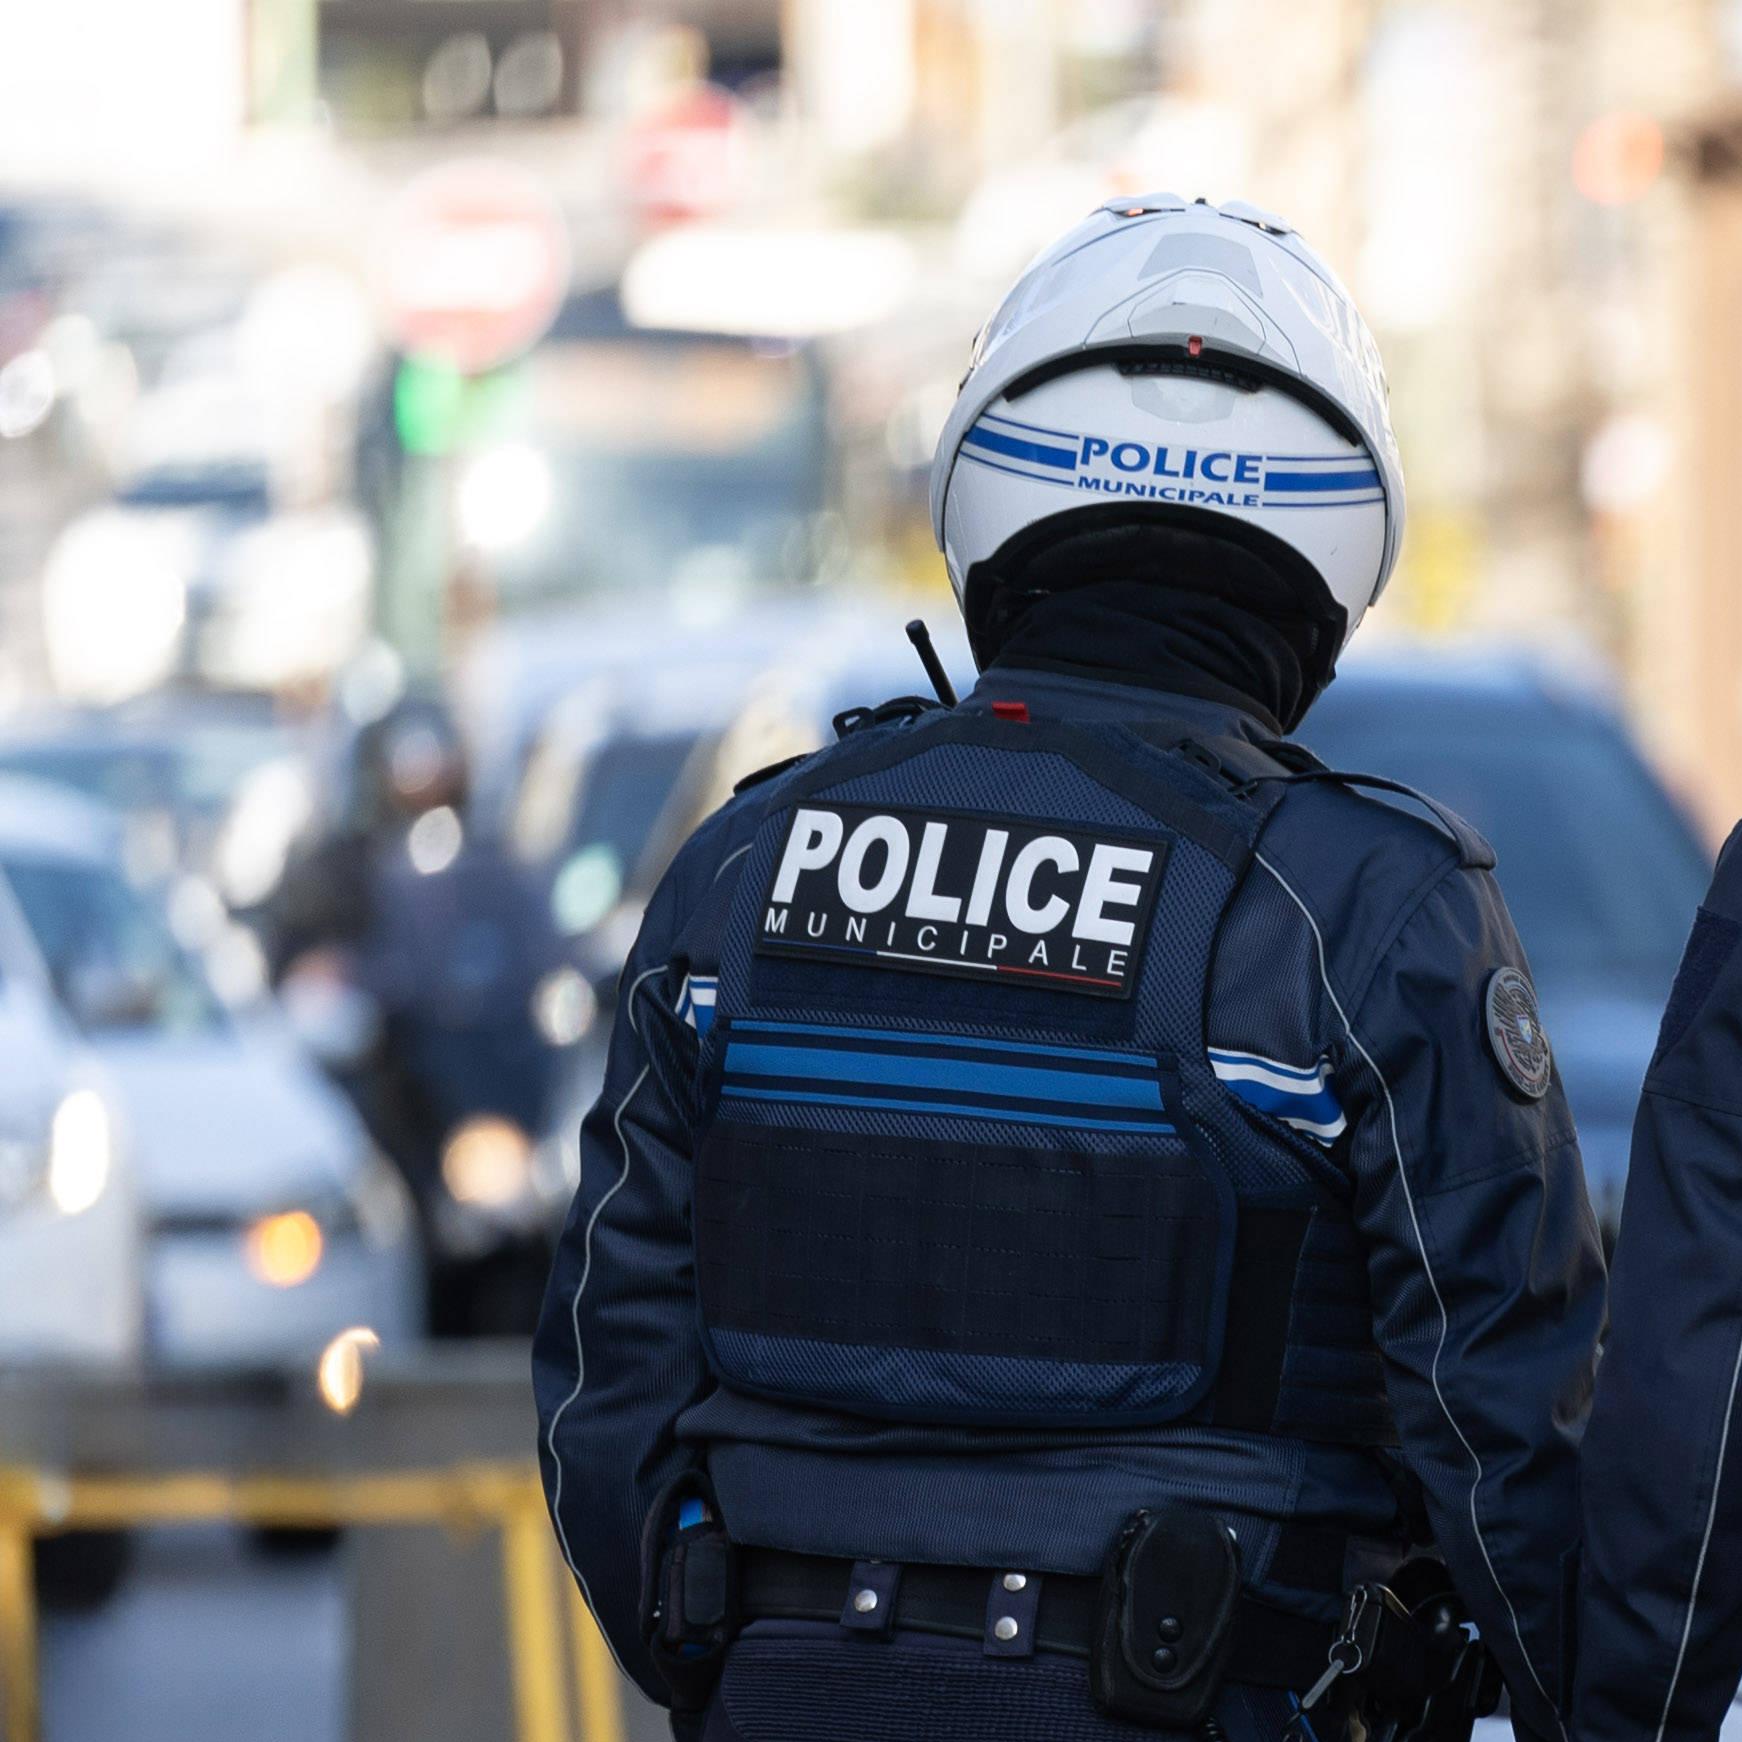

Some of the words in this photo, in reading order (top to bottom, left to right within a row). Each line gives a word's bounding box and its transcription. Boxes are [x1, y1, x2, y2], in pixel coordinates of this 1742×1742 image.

[1080, 437, 1262, 483] POLICE
[1079, 476, 1259, 506] MUNICIPALE
[771, 809, 1153, 946] POLICE
[764, 907, 1129, 976] MUNICIPALE
